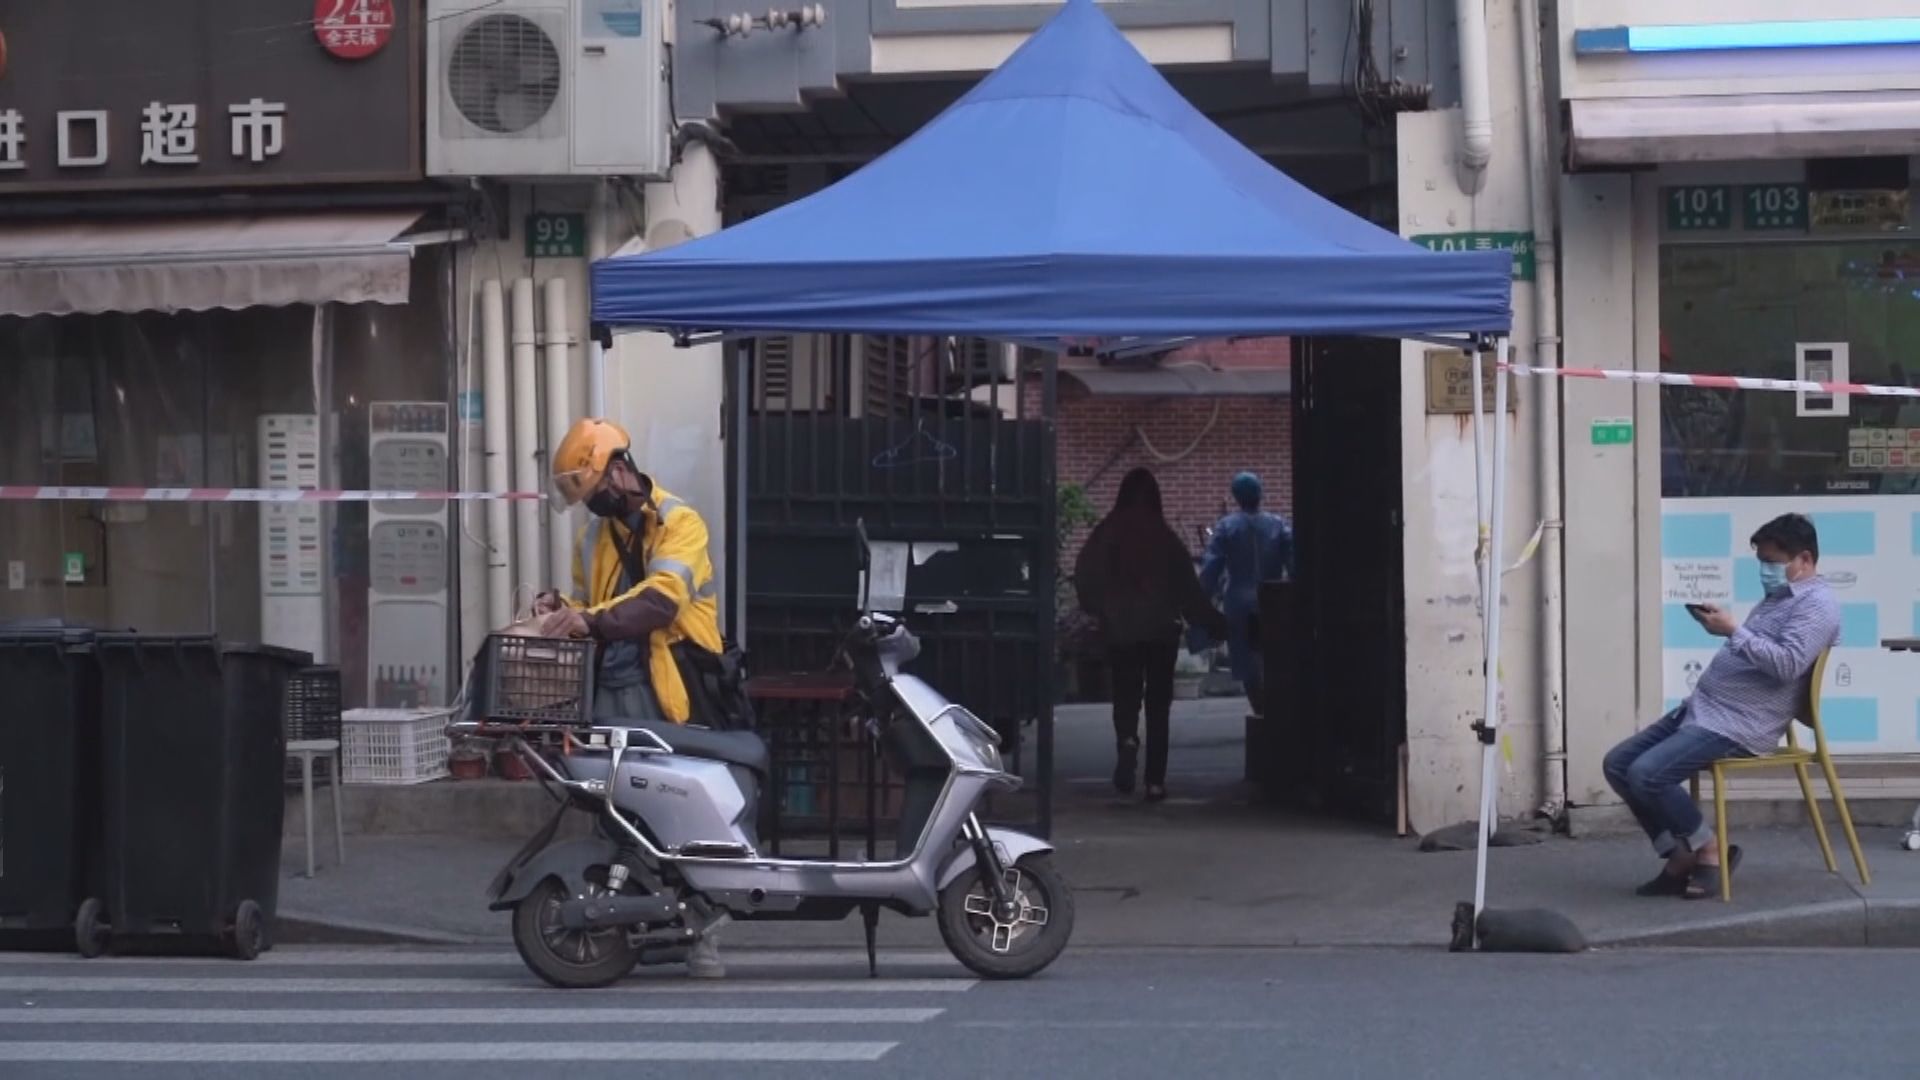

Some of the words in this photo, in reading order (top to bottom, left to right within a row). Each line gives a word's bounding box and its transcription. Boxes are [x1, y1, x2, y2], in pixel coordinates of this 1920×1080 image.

[1674, 188, 1724, 213] 101
[1750, 187, 1799, 213] 103
[536, 217, 569, 242] 99
